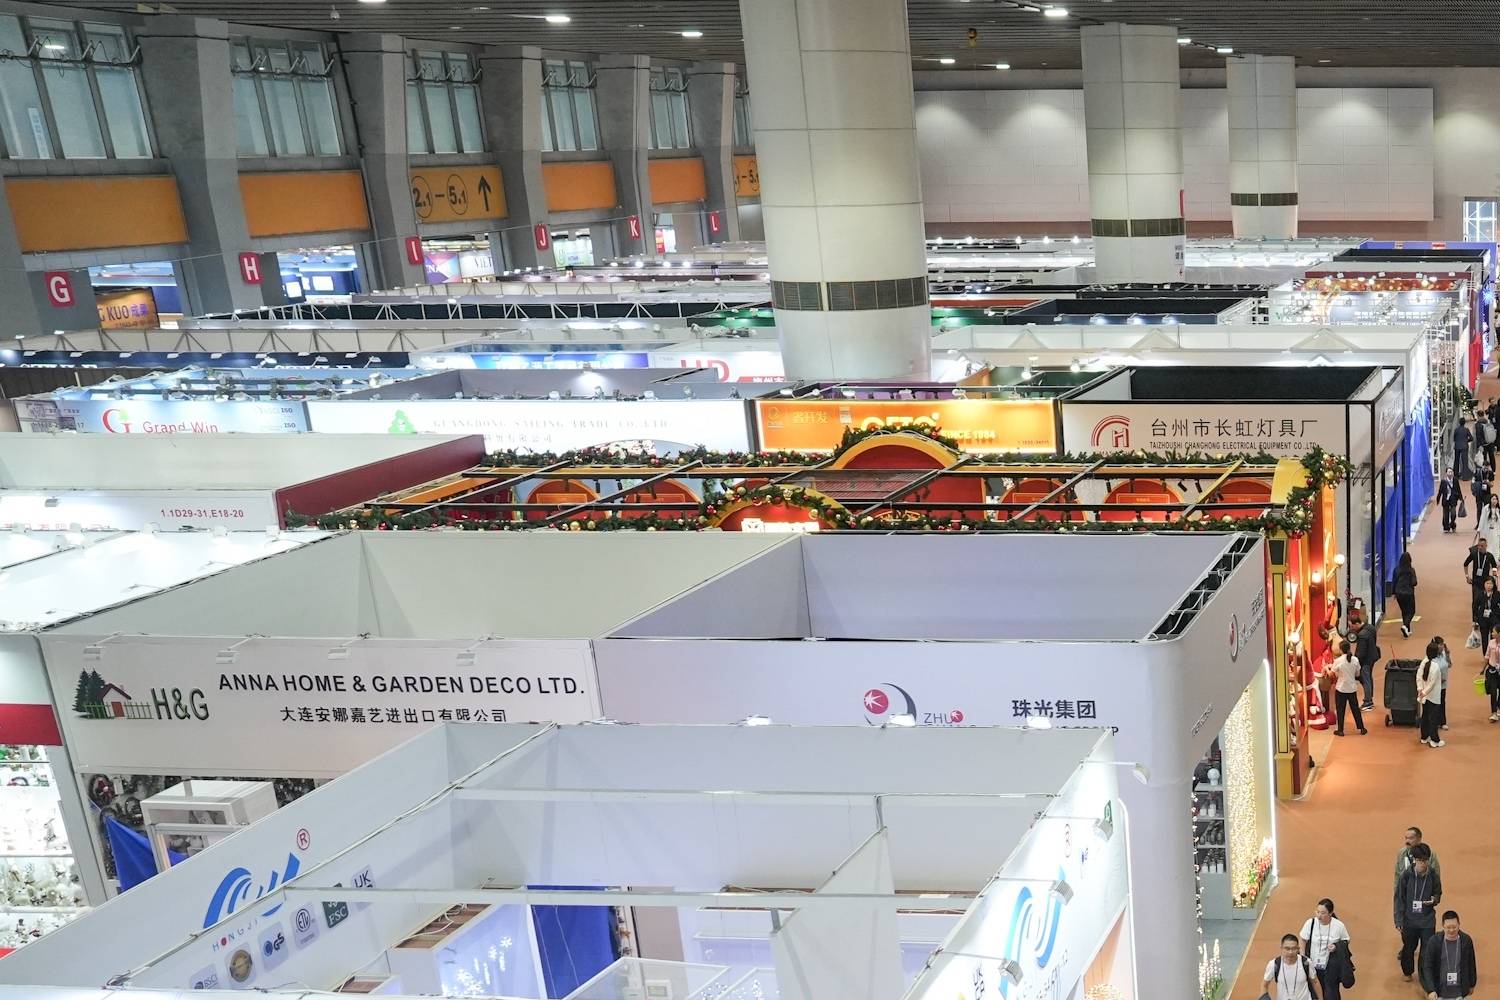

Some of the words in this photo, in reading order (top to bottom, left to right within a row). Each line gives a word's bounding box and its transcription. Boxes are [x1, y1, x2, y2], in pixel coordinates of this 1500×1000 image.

[630, 218, 639, 237] K
[711, 215, 718, 231] L
[539, 230, 546, 246] J
[243, 257, 260, 281] H
[50, 276, 71, 303] G
[143, 421, 186, 433] Grand
[191, 421, 219, 433] Win
[1150, 418, 1318, 438] 台州市长虹灯具厂
[1149, 441, 1183, 450] TAIZHOUSHI
[1185, 441, 1221, 450] CHANGHONG
[1222, 441, 1257, 450] ELECTRICAL
[1258, 441, 1292, 450] EQUIPMENT
[219, 673, 279, 692] ANNA
[282, 674, 346, 693] HOME
[353, 675, 366, 692] &
[372, 675, 464, 694] GARDEN
[469, 676, 531, 694] DECO
[538, 677, 586, 695] LTD.
[151, 687, 210, 722] H&G
[1012, 699, 1097, 720] 珠光集团
[329, 906, 348, 925] FSC
[273, 932, 285, 952] GS
